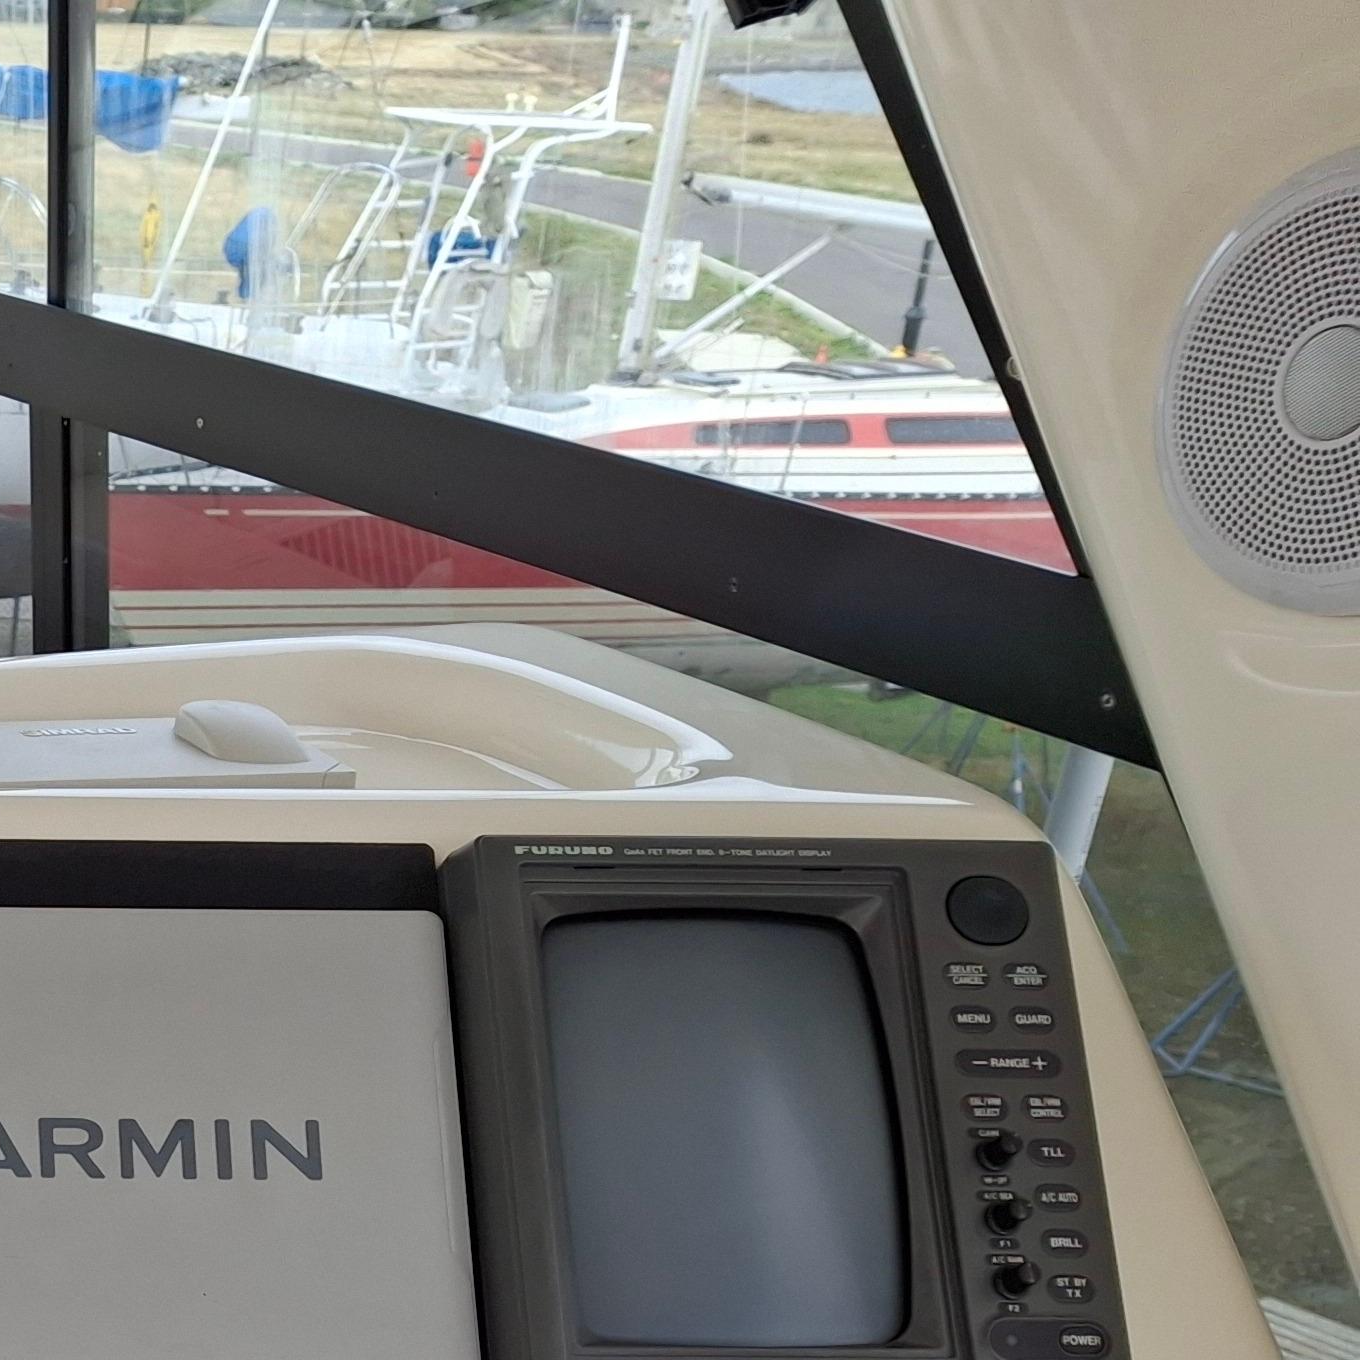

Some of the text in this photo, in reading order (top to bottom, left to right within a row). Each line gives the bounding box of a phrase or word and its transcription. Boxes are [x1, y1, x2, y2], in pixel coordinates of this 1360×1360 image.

[514, 845, 614, 855] FURUNO
[666, 848, 693, 856] FRONT
[756, 849, 795, 857] DAYLIGHT
[798, 849, 831, 857] DISPLAY
[949, 964, 984, 973] SELECT
[957, 1013, 991, 1024] MENU
[1015, 1014, 1051, 1025] GUARD
[990, 1057, 1030, 1068] RANGE
[1041, 1147, 1065, 1158] TLL
[1041, 1192, 1078, 1203] A/C AUTO
[1050, 1237, 1083, 1248] BRILL
[1062, 1335, 1102, 1346] POWER
